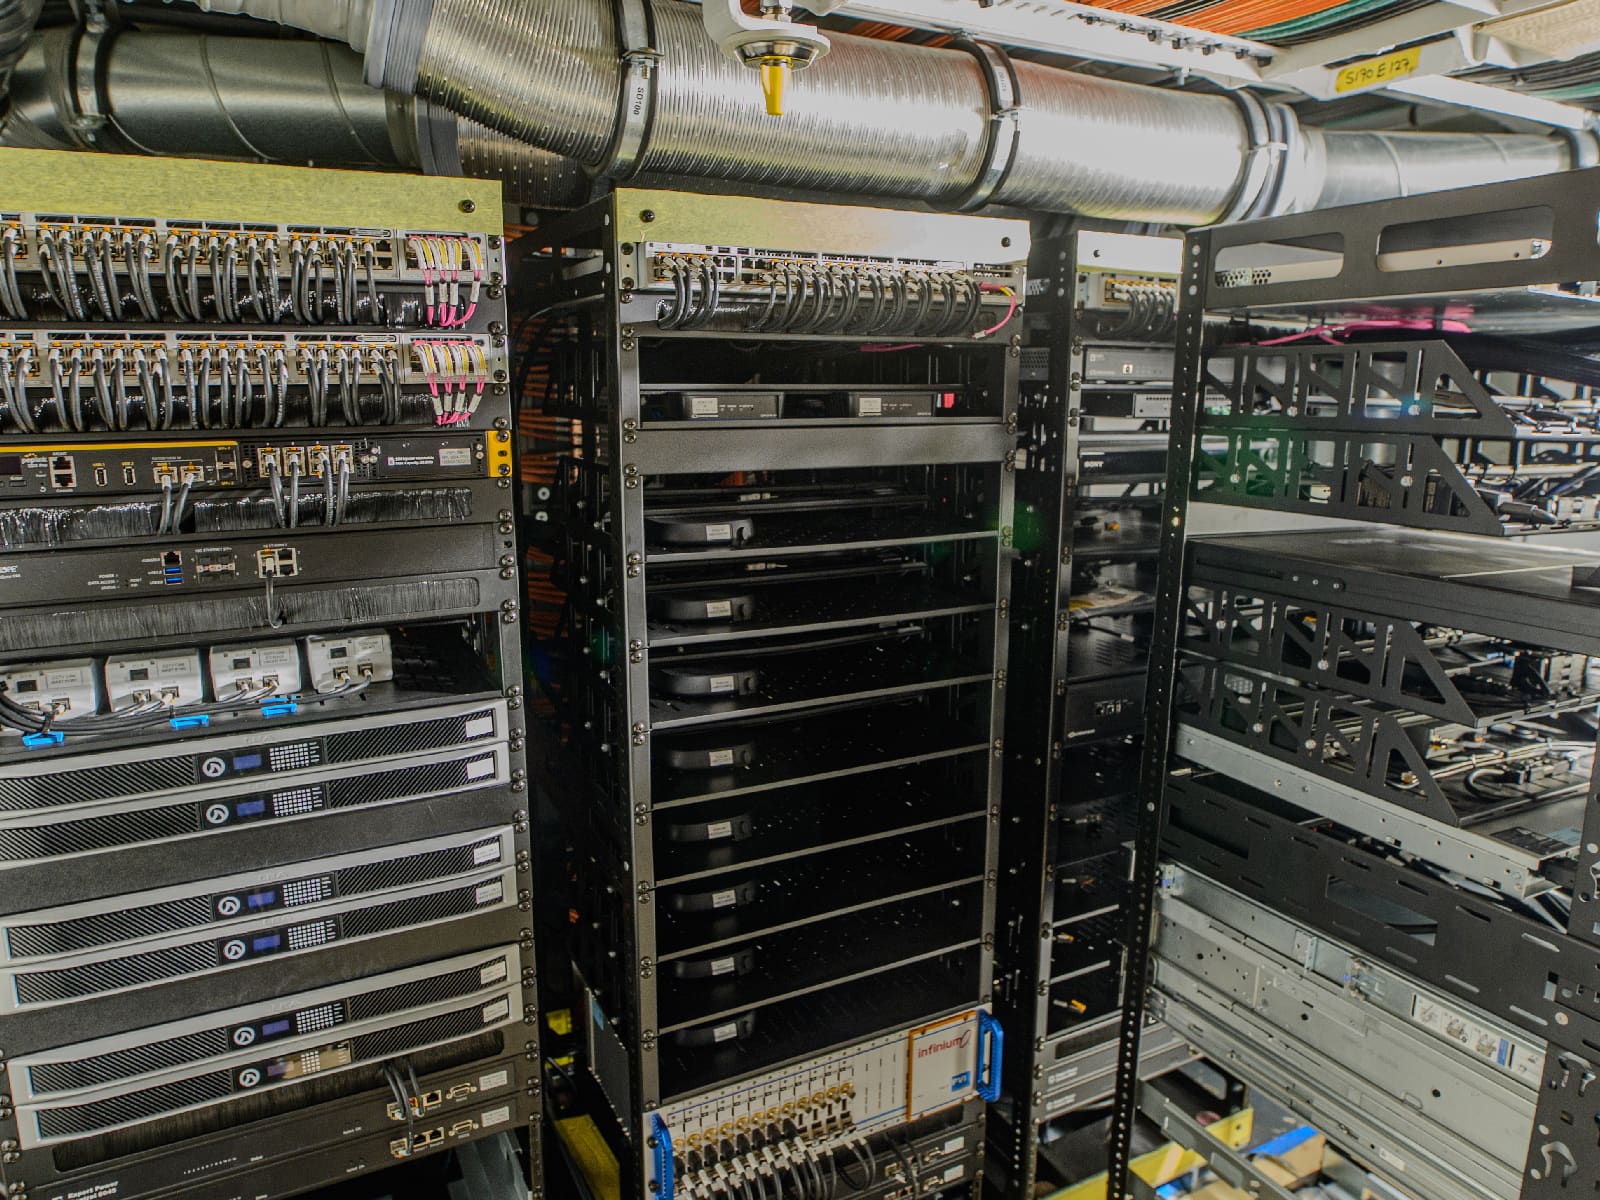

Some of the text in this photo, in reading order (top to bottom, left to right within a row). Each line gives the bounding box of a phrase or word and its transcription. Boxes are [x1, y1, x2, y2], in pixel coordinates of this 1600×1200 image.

[633, 87, 644, 115] SD100
[918, 1037, 963, 1058] infinium
[95, 1181, 119, 1191] Power
